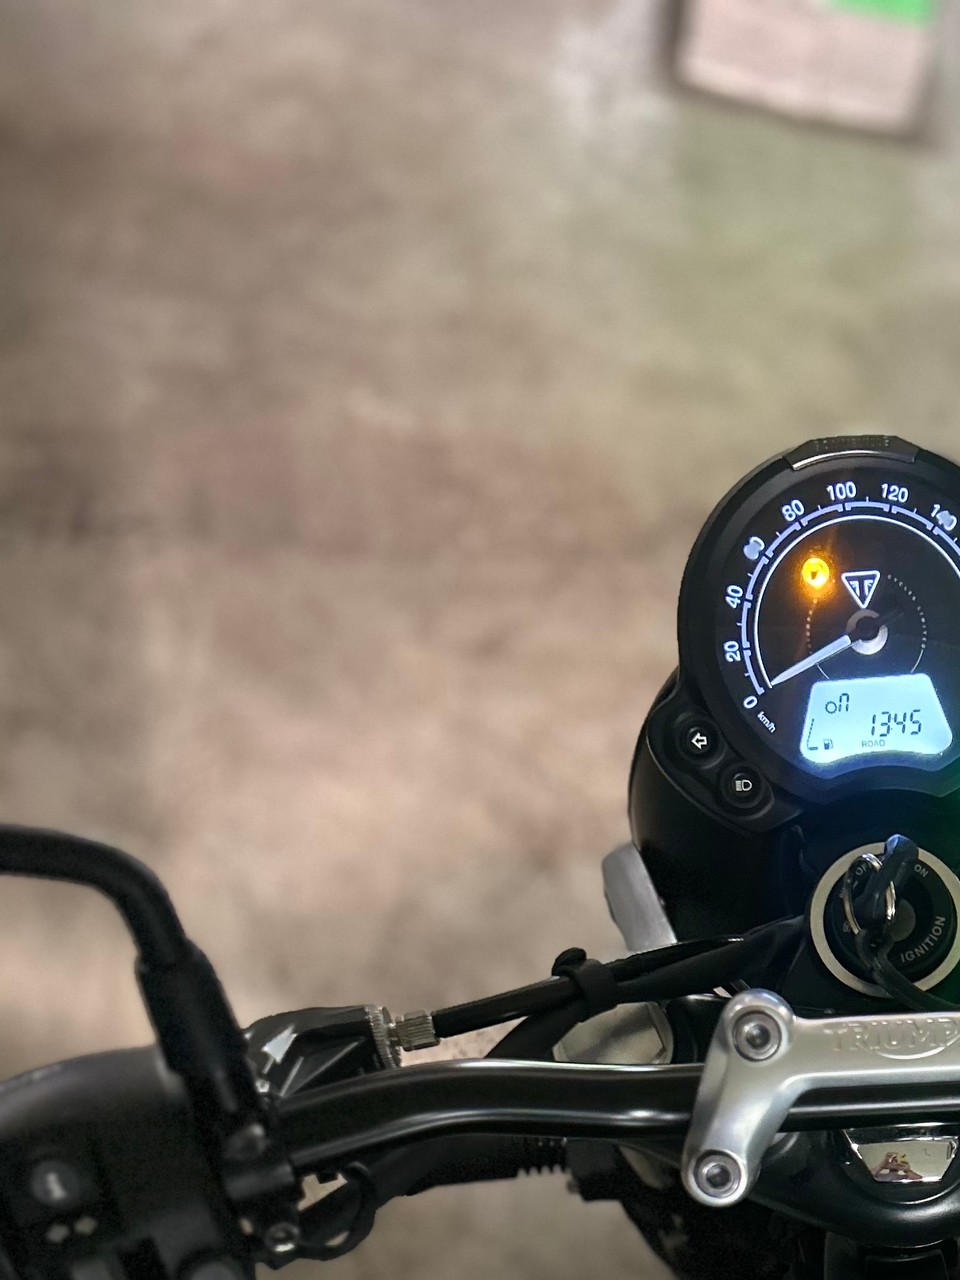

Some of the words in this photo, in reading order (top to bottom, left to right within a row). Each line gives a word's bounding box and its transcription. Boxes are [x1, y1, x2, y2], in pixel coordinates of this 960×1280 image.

[826, 481, 857, 500] 100
[881, 483, 909, 503] 120
[781, 499, 805, 521] 80
[725, 585, 744, 609] 40
[723, 640, 741, 662] 20
[743, 695, 758, 709] 0
[757, 711, 776, 733] km/h
[871, 709, 922, 737] 1345
[861, 739, 886, 748] ROAD
[913, 863, 929, 878] ON
[900, 915, 946, 963] IGNITION
